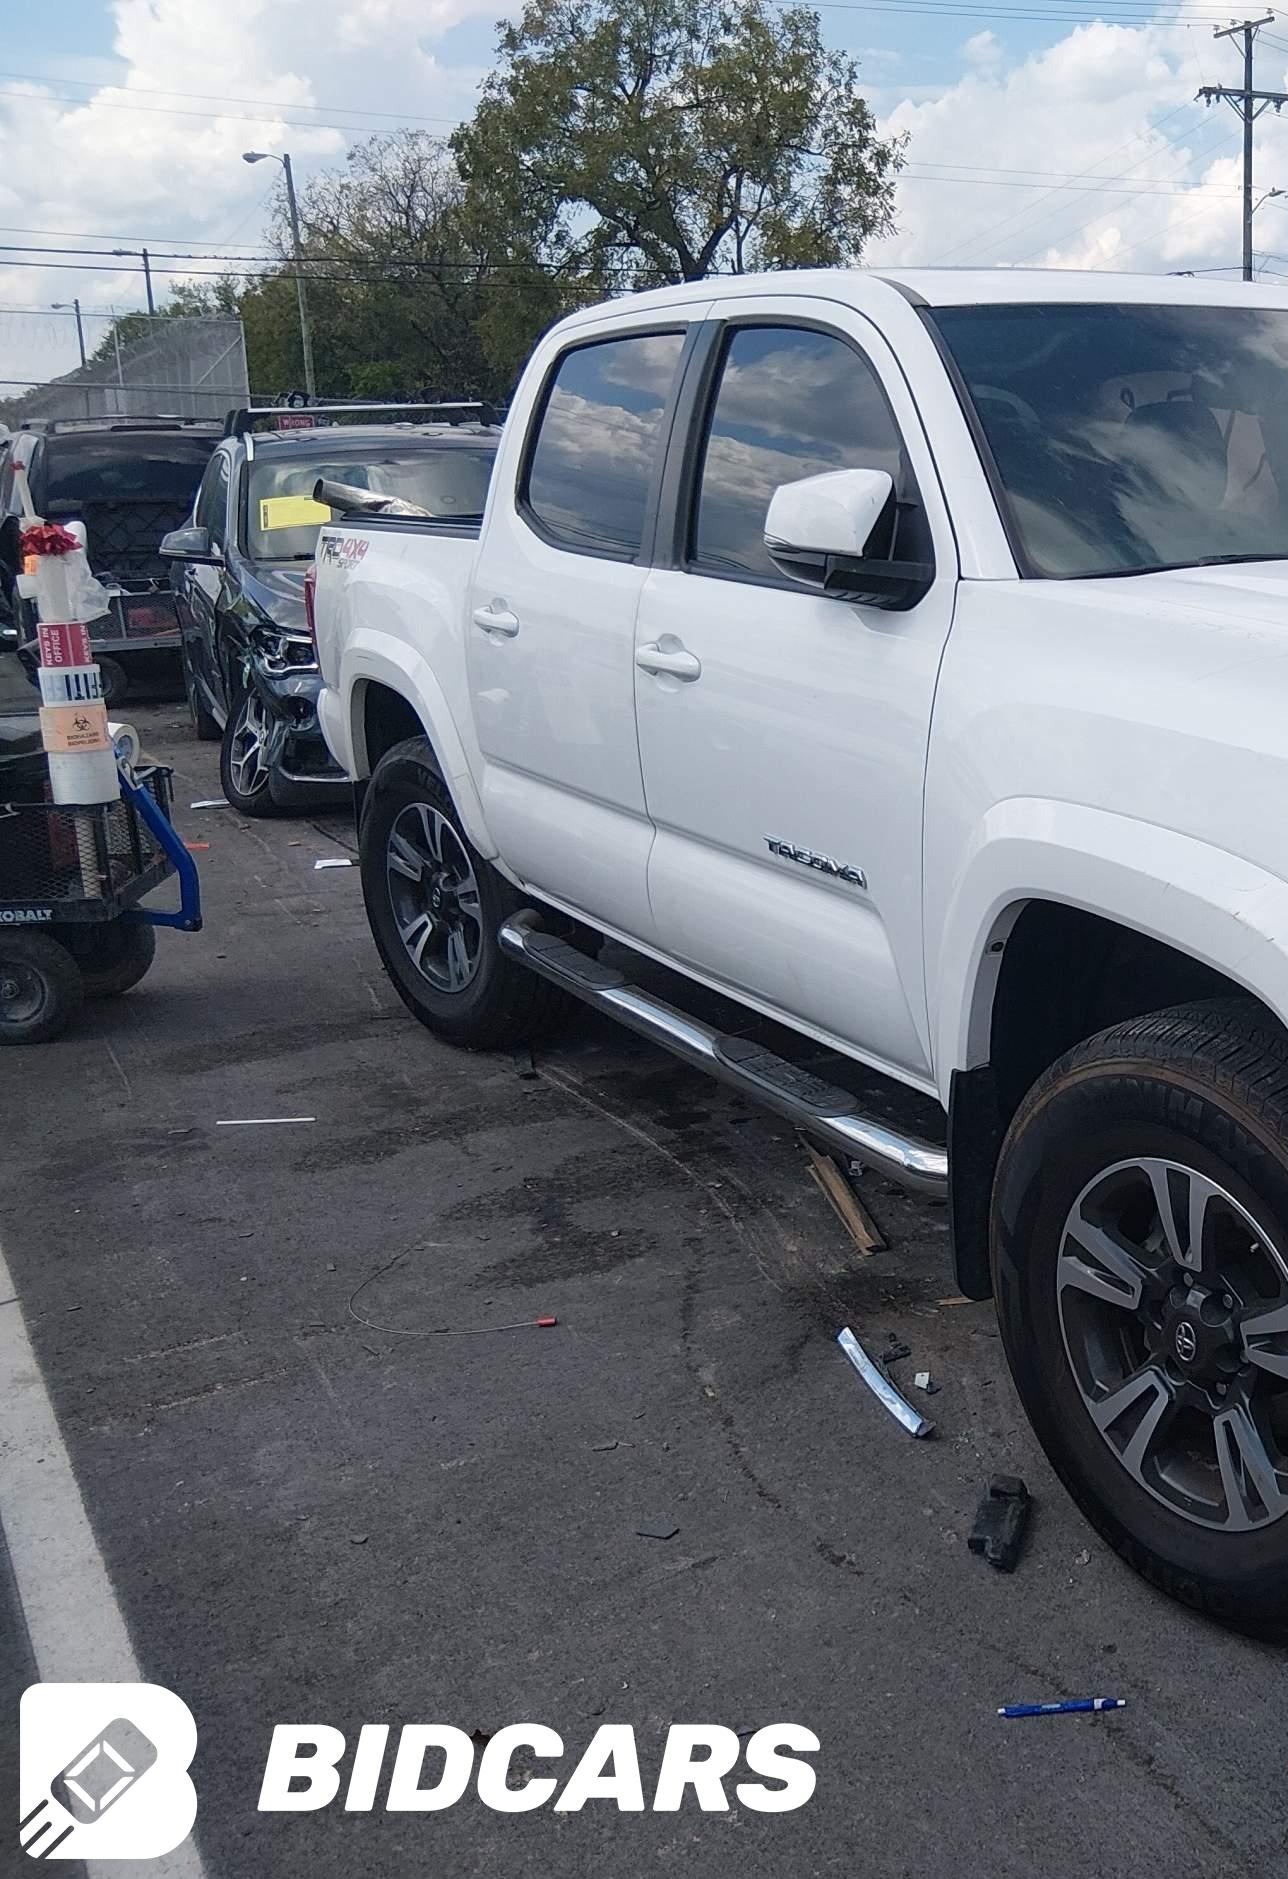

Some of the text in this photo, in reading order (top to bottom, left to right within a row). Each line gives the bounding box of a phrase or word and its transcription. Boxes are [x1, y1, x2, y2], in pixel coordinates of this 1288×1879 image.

[321, 536, 344, 565] TRD
[41, 627, 53, 666] KEYS IN
[50, 629, 63, 663] OFFICE
[763, 832, 868, 890] TACOMA
[0, 909, 53, 922] OBALT
